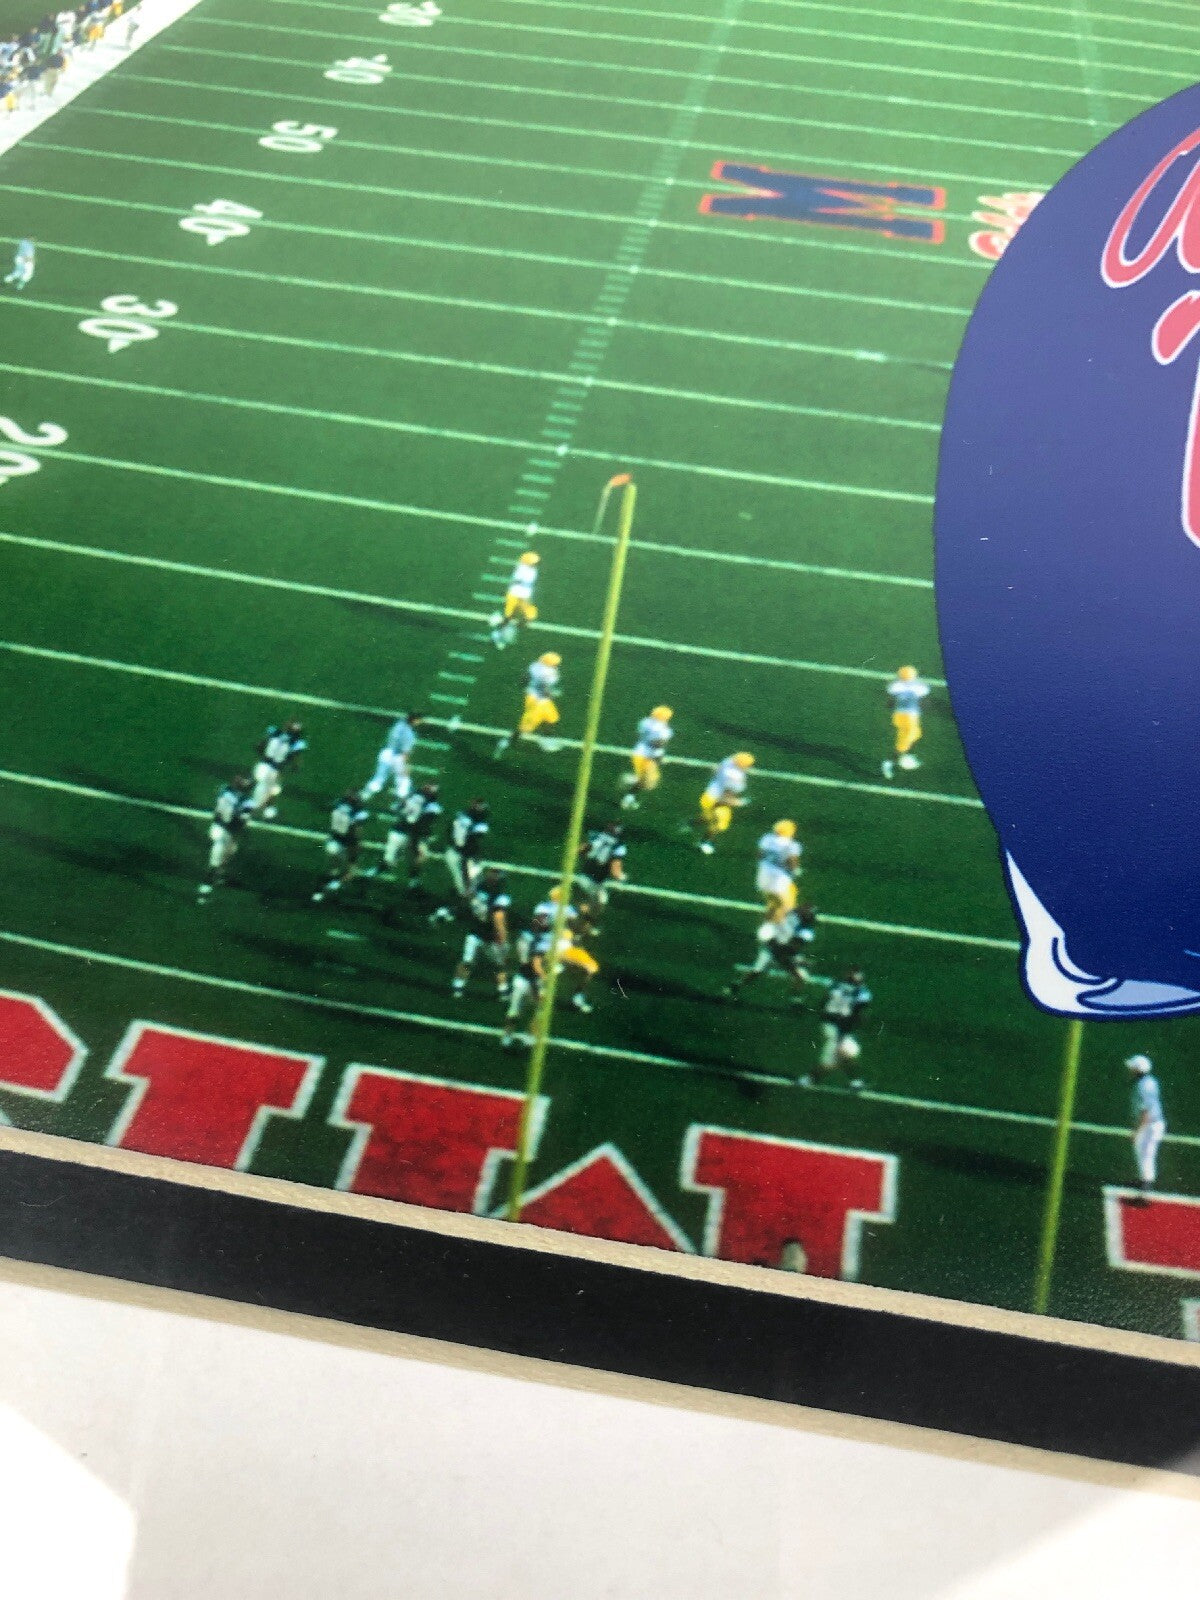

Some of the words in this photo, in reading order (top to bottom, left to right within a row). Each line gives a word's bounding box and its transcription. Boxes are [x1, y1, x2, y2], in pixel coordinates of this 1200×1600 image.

[324, 55, 392, 85] 40
[258, 119, 338, 154] 50
[178, 199, 263, 237] 40
[78, 294, 179, 341] 30
